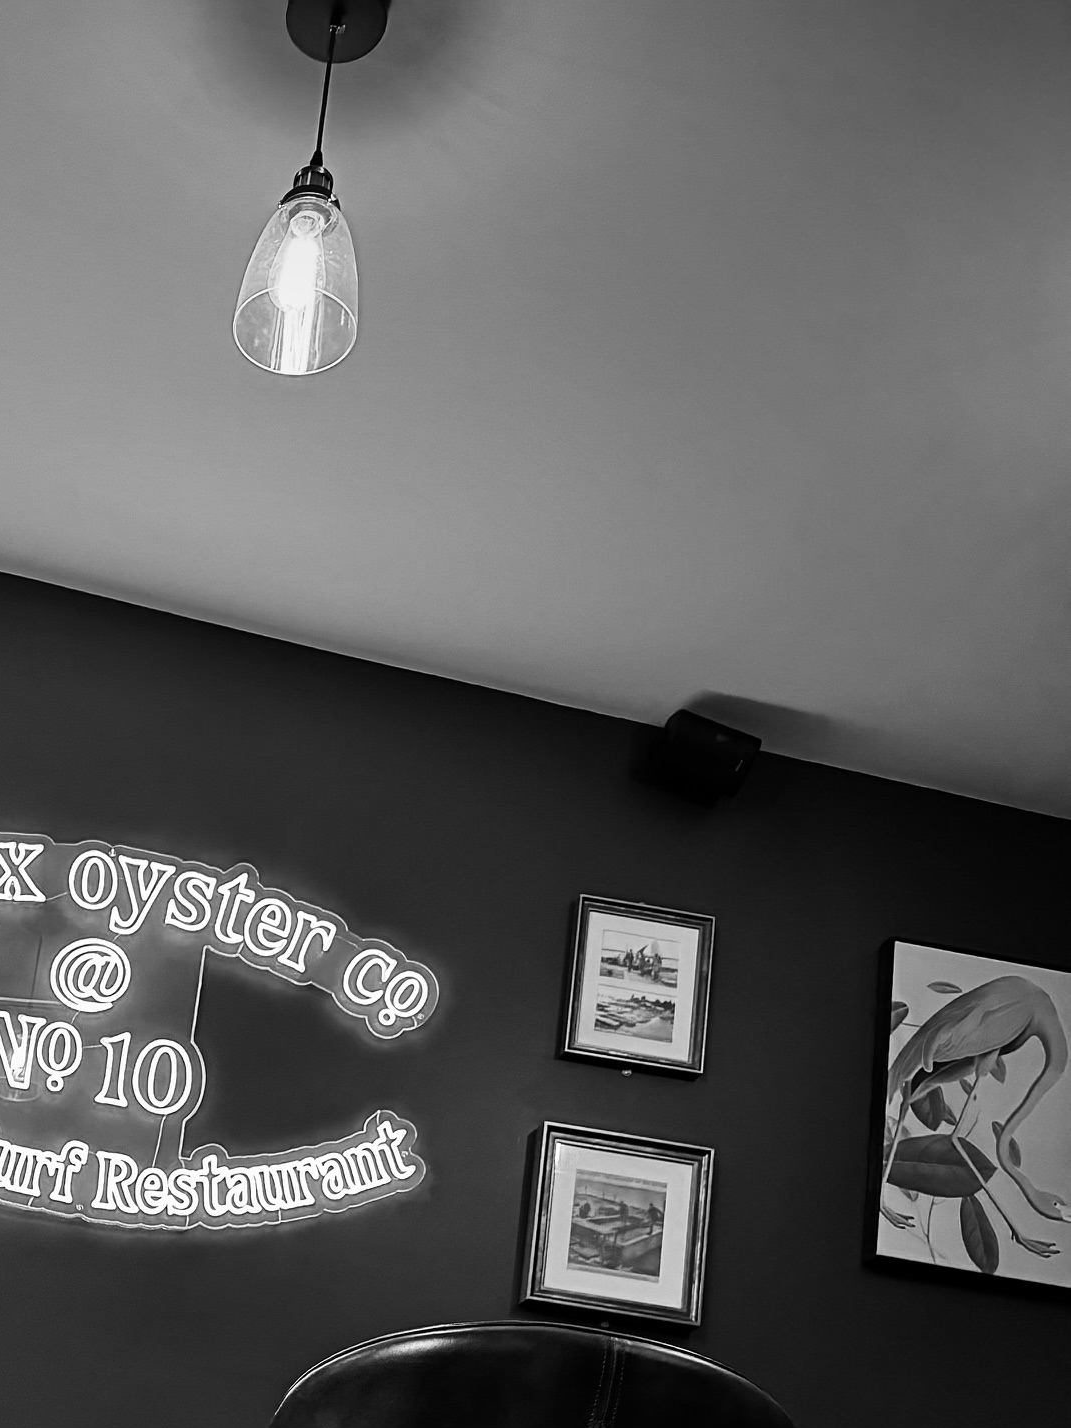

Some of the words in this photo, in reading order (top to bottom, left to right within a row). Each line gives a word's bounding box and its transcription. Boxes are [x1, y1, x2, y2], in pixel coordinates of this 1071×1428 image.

[68, 849, 336, 974] oyster
[50, 938, 132, 1012] @
[94, 1033, 195, 1115] 10
[96, 1122, 416, 1216] Restaurant
